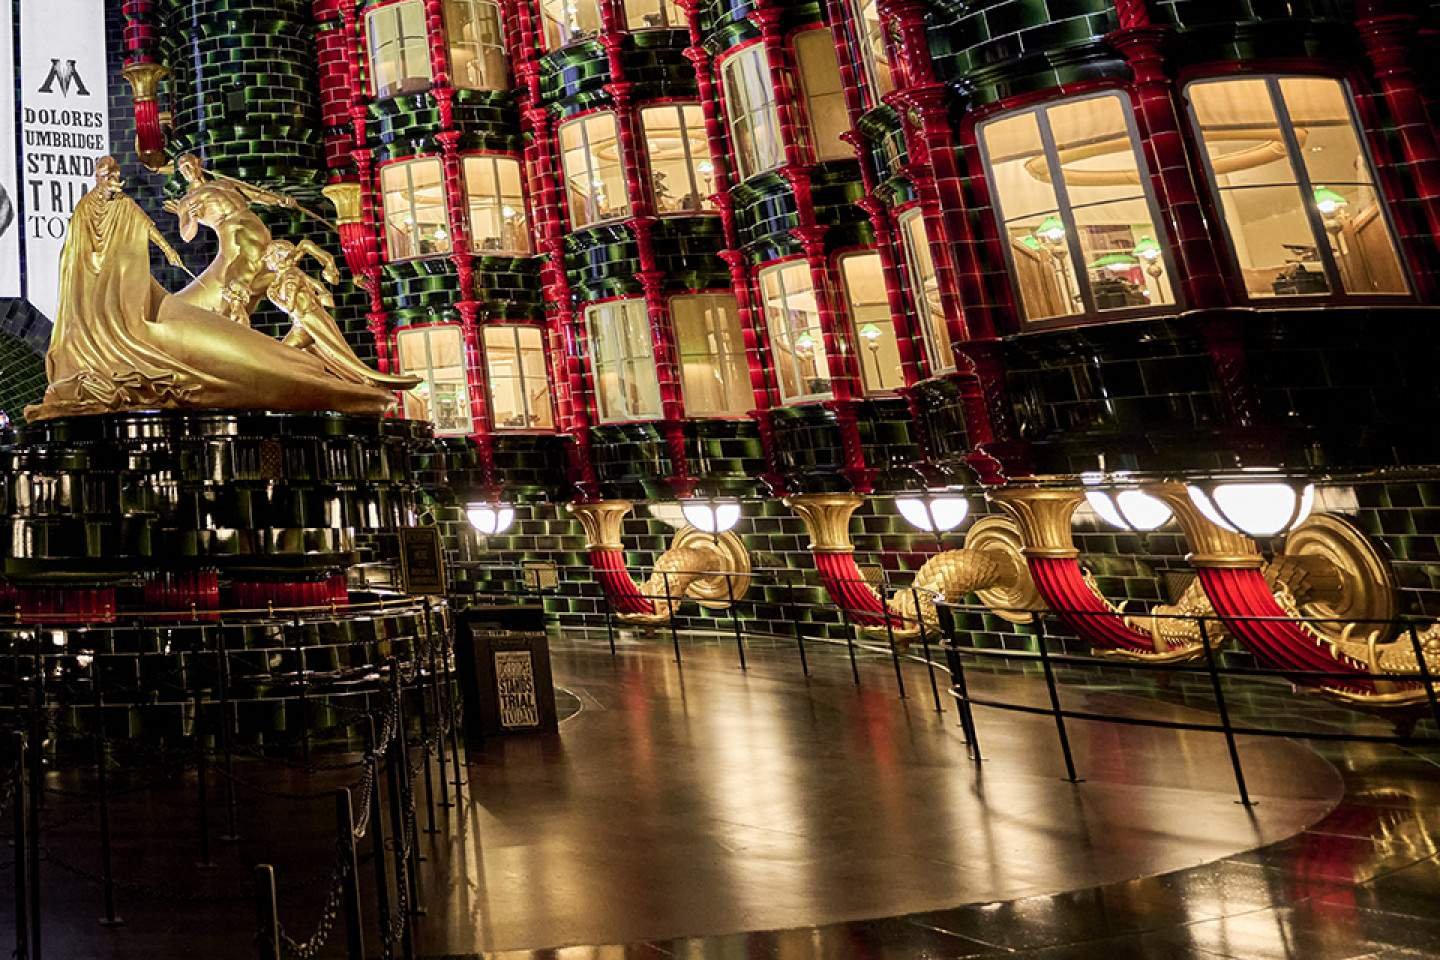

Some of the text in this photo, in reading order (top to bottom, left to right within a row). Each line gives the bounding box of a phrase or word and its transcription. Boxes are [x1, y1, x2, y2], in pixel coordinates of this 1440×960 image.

[24, 107, 103, 128] DOLORES
[24, 129, 104, 150] UMBRIDGE
[27, 152, 99, 177] STAND
[28, 179, 88, 213] TRI
[500, 693, 537, 708] TRIAL
